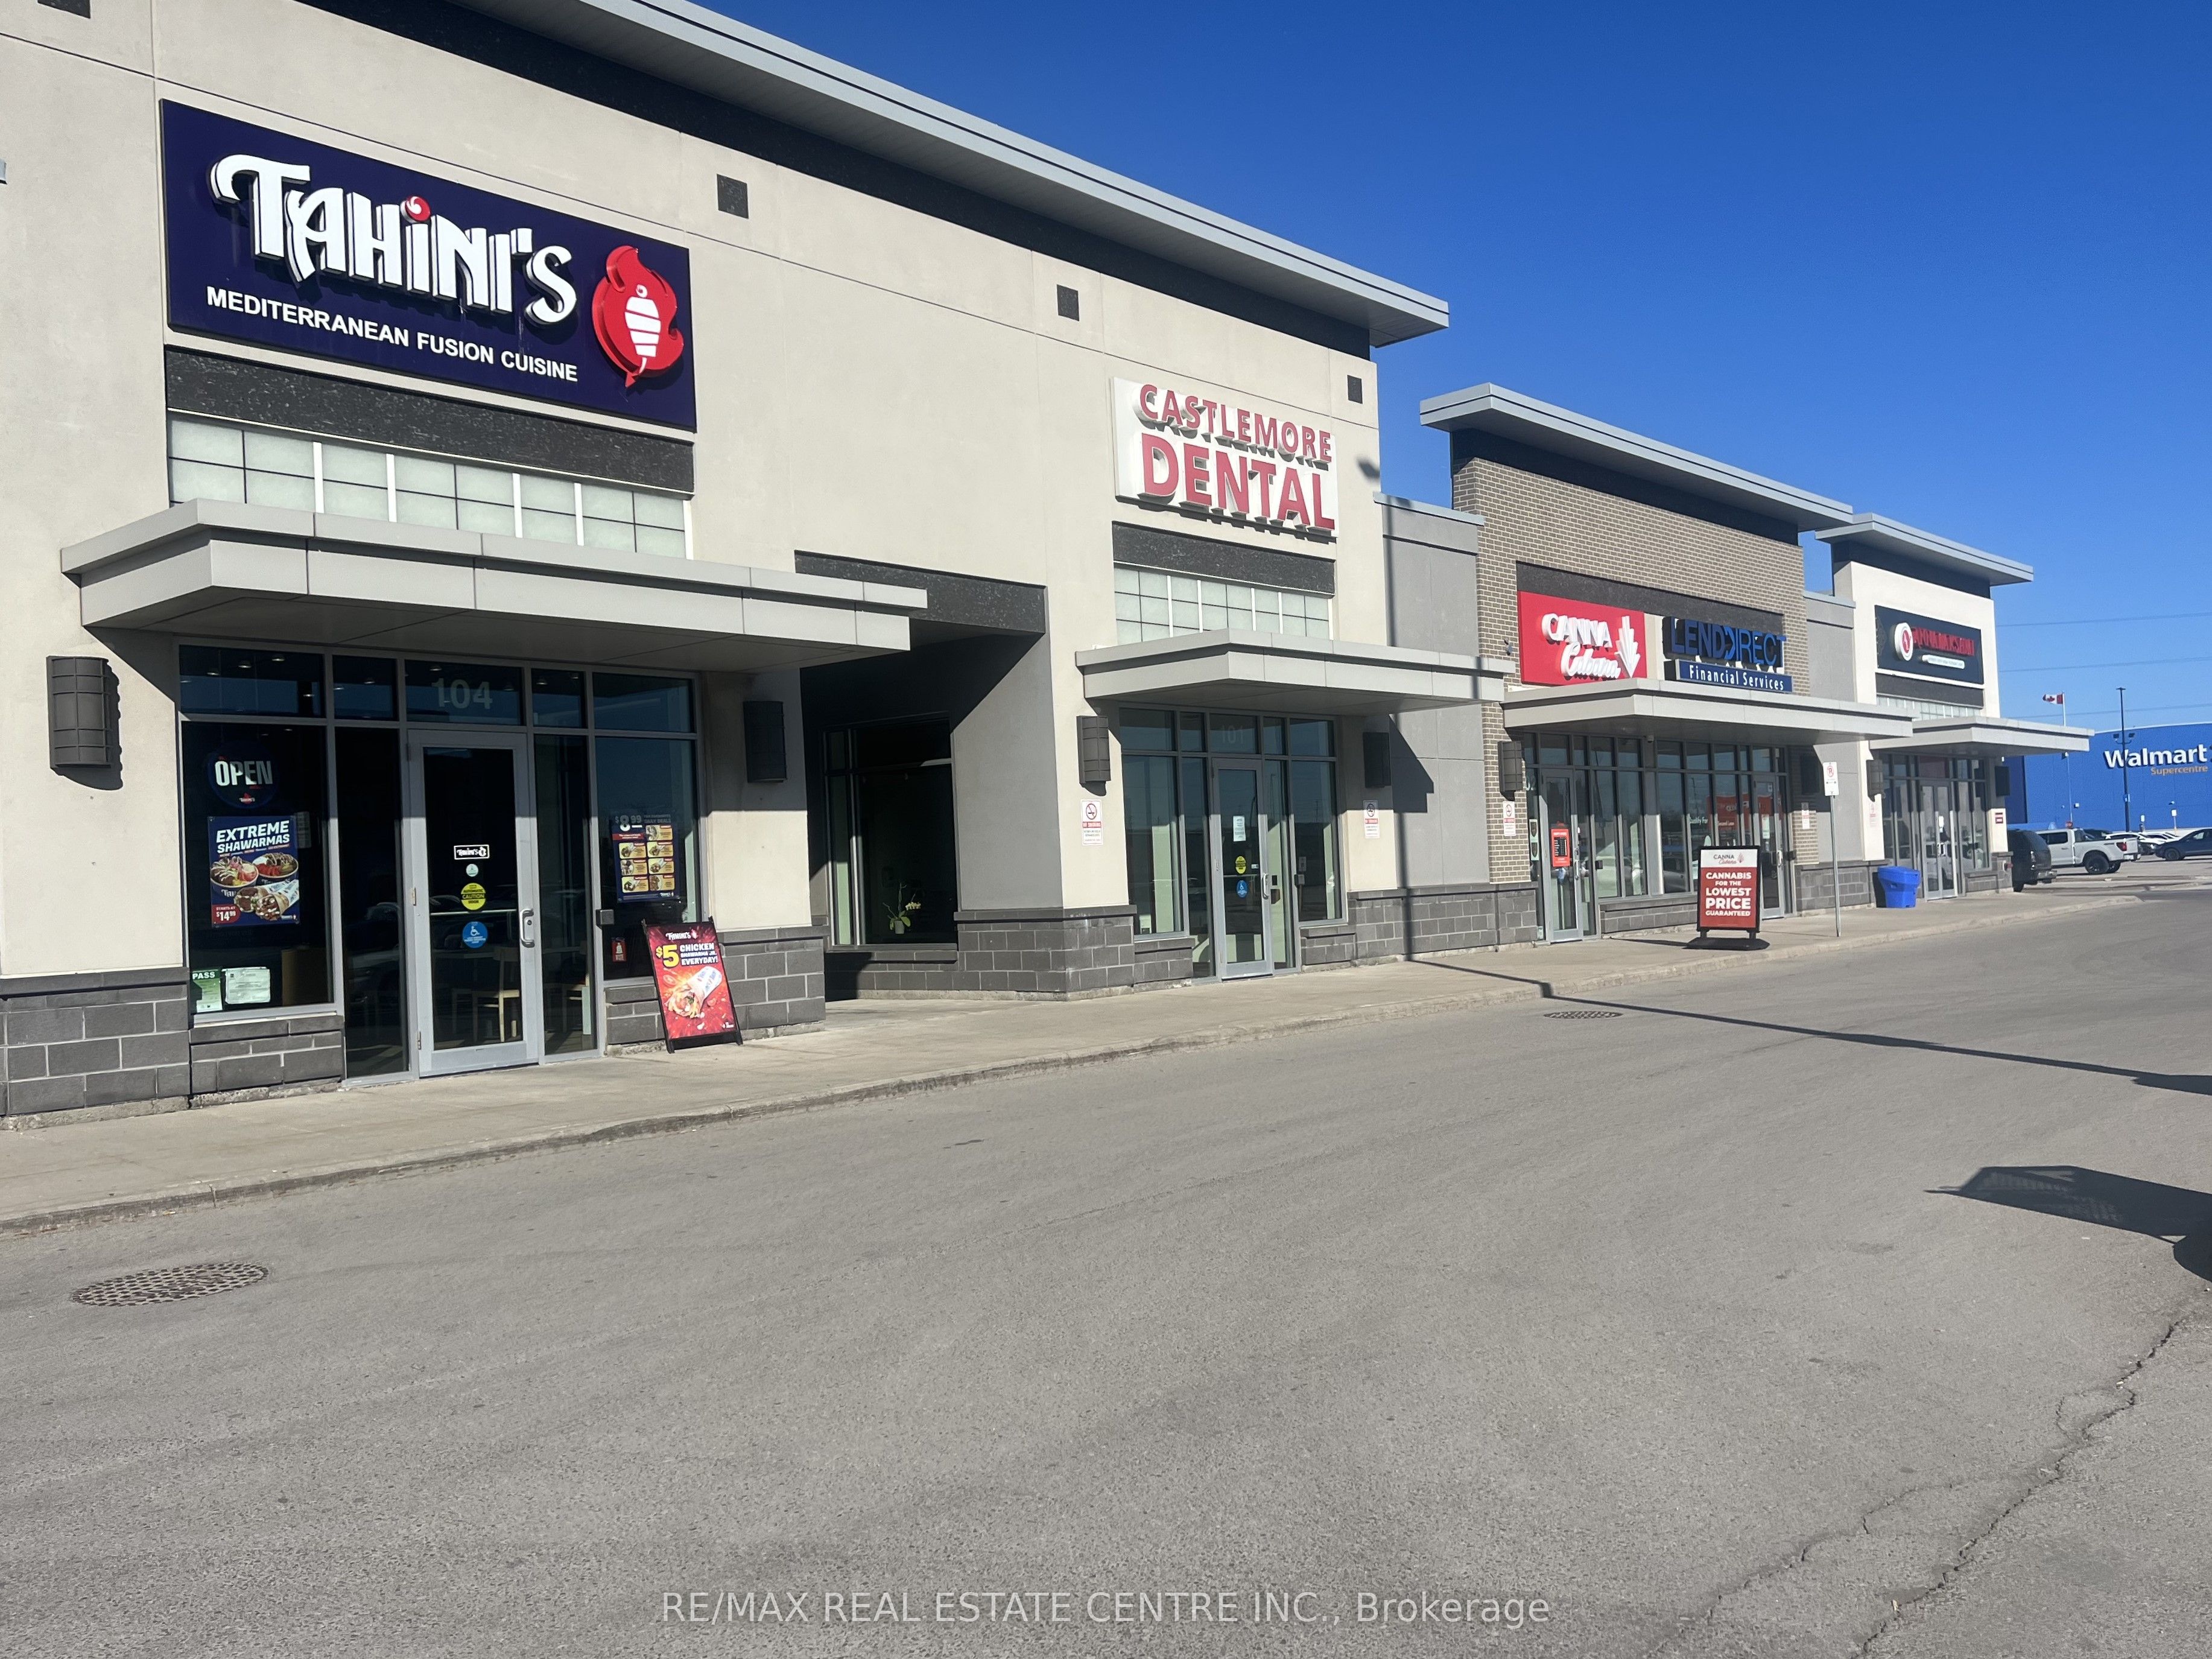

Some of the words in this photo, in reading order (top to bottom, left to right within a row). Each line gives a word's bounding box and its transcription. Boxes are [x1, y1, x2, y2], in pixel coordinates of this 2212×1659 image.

[207, 286, 409, 347] MEDITERRANEAN
[417, 332, 494, 364] FUSION
[501, 351, 577, 382] CUISINE
[1139, 384, 1333, 463] CASTLEMORE
[1141, 433, 1335, 530] DENTAL
[1542, 613, 1612, 648] CANNA
[1689, 664, 1738, 685] Financial
[1743, 672, 1784, 691] Services
[431, 678, 493, 709] 104
[2104, 744, 2208, 769] Walmart
[215, 760, 273, 787] OPEN
[2150, 765, 2208, 776] Supercentre
[216, 820, 290, 843] EXTREME
[217, 834, 290, 854] SHAWARMAS
[1705, 887, 1752, 896] LOWEST
[1705, 898, 1751, 910] PRICE
[656, 944, 680, 968] $5
[679, 942, 715, 953] CHICKEN
[681, 957, 719, 966] EVERYDAY!
[192, 971, 215, 980] PASS
